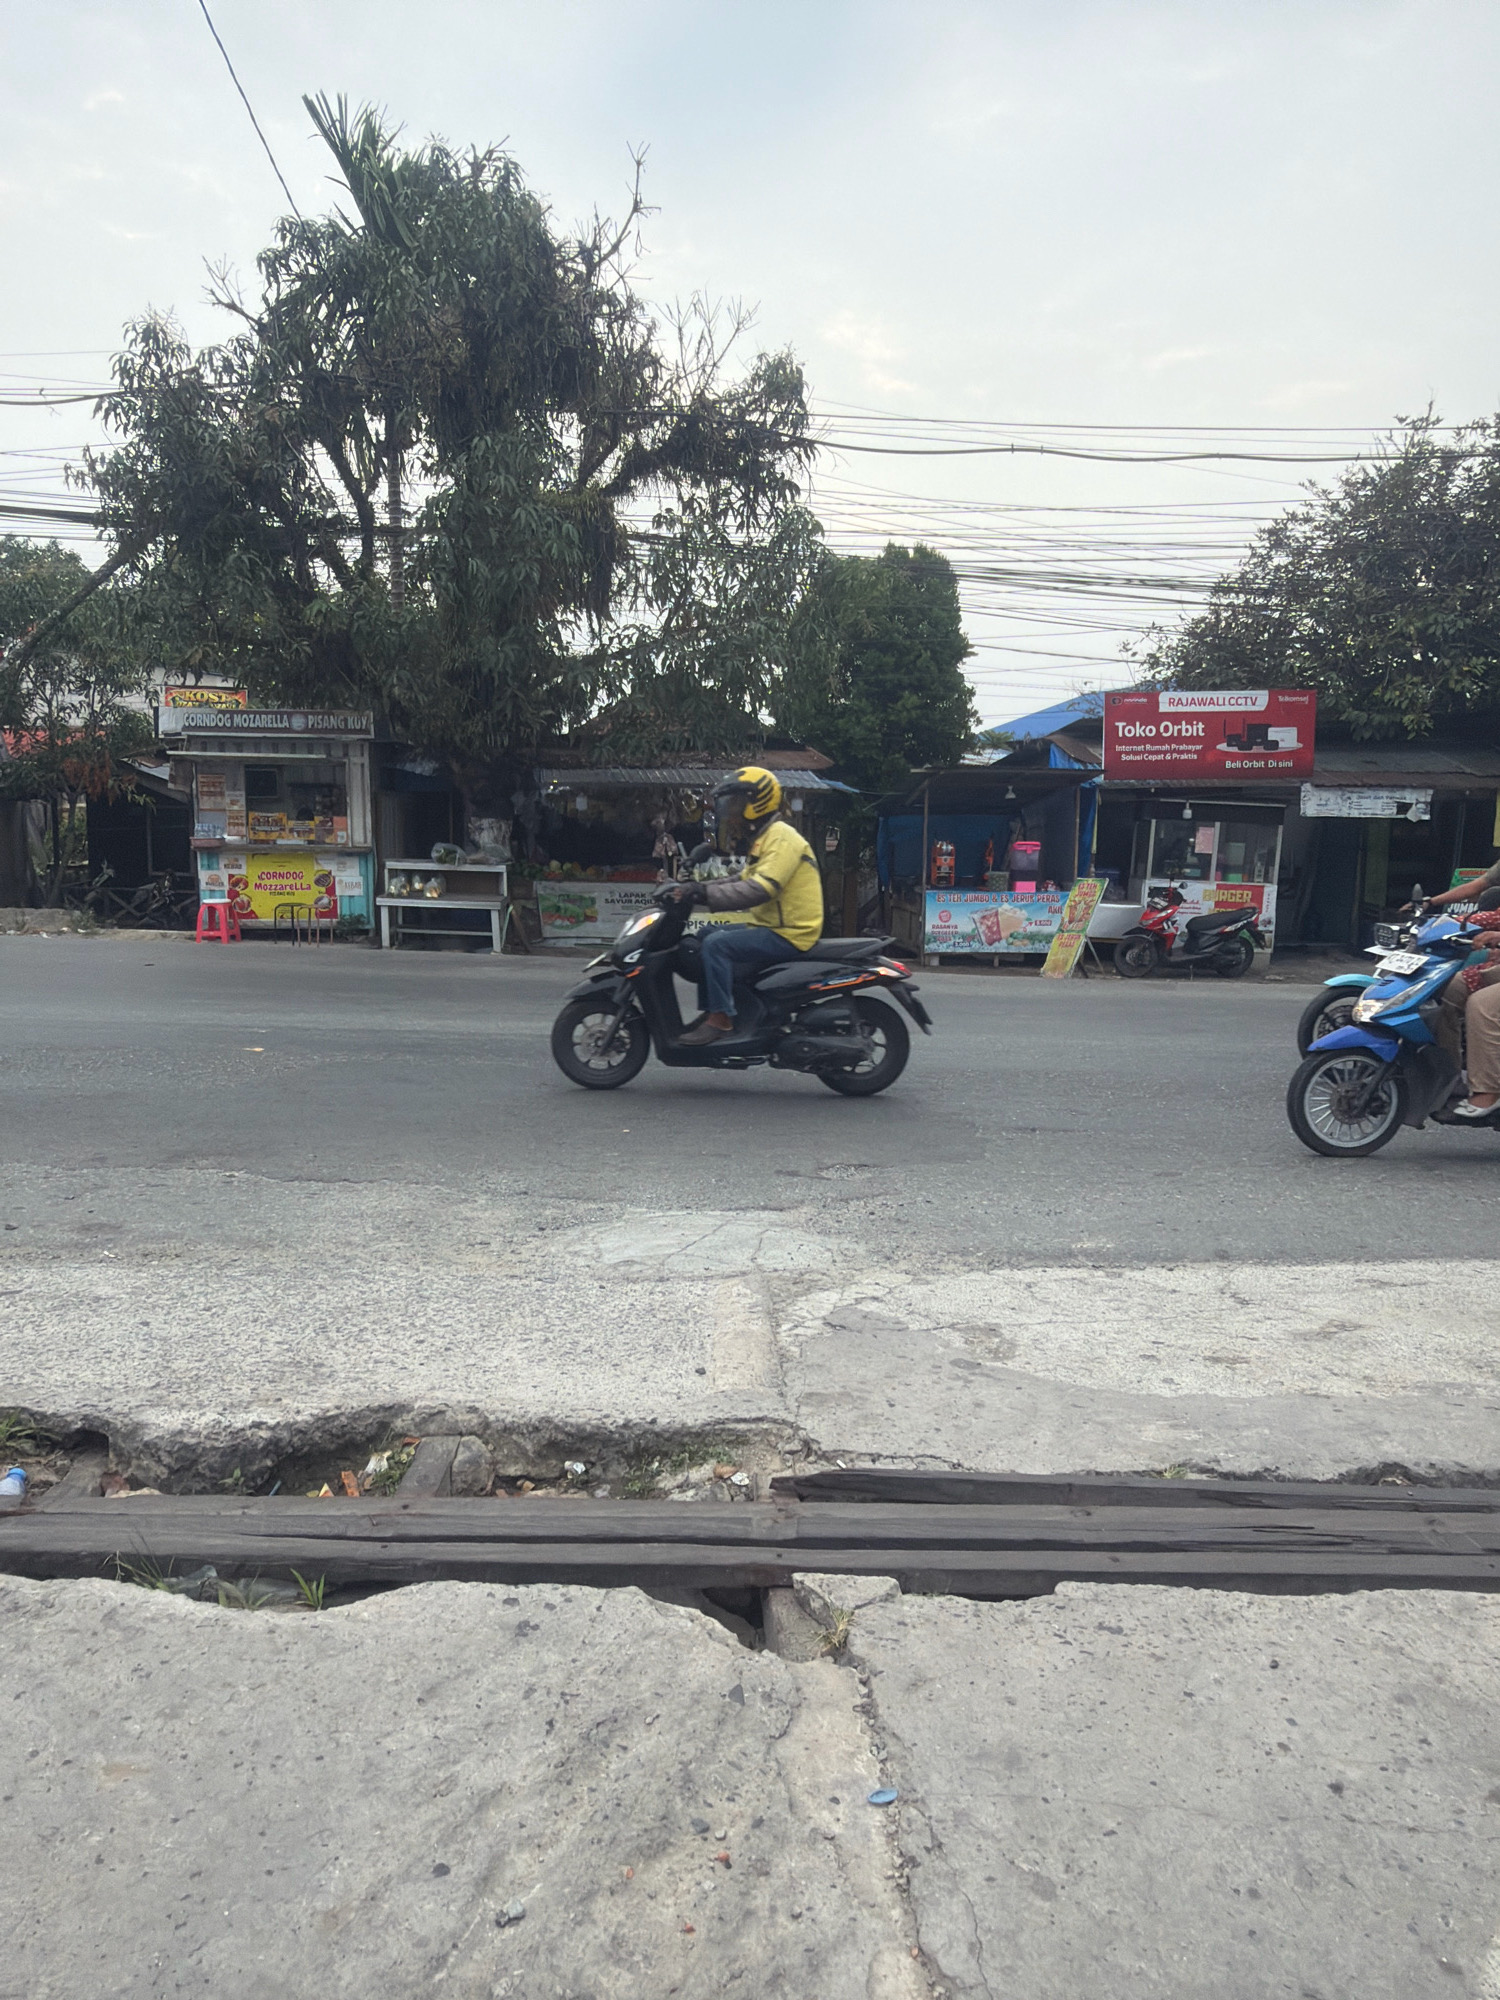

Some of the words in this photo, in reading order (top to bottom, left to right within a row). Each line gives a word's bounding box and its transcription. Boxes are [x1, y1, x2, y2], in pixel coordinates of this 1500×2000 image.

[185, 690, 228, 702] KOST
[1168, 696, 1226, 707] RAJAWALI
[1228, 696, 1258, 707] CCTV
[183, 713, 231, 727] CORNDOG
[233, 714, 289, 728] MOZARELLA
[308, 714, 345, 729] PISANG
[347, 716, 367, 729] KUY
[1115, 721, 1156, 737] Toko
[1160, 720, 1205, 737] Orbit
[1171, 743, 1203, 752] Prabayar
[1121, 753, 1143, 761] Solusi
[1144, 753, 1164, 762] Cepat
[1172, 752, 1198, 760] Praktis
[1225, 760, 1241, 769] Beli
[1242, 760, 1265, 769] Orbit
[1268, 759, 1277, 768] Di
[1278, 759, 1293, 768] sini
[258, 871, 304, 880] CORNDOG
[936, 893, 946, 902] ES
[948, 894, 962, 903] TEH
[964, 894, 989, 903] JUMBO
[991, 894, 998, 903] &
[1000, 894, 1009, 903] ES
[1011, 894, 1034, 903] JERUK
[1037, 894, 1060, 903] PERAS
[1202, 888, 1252, 903] BURGER
